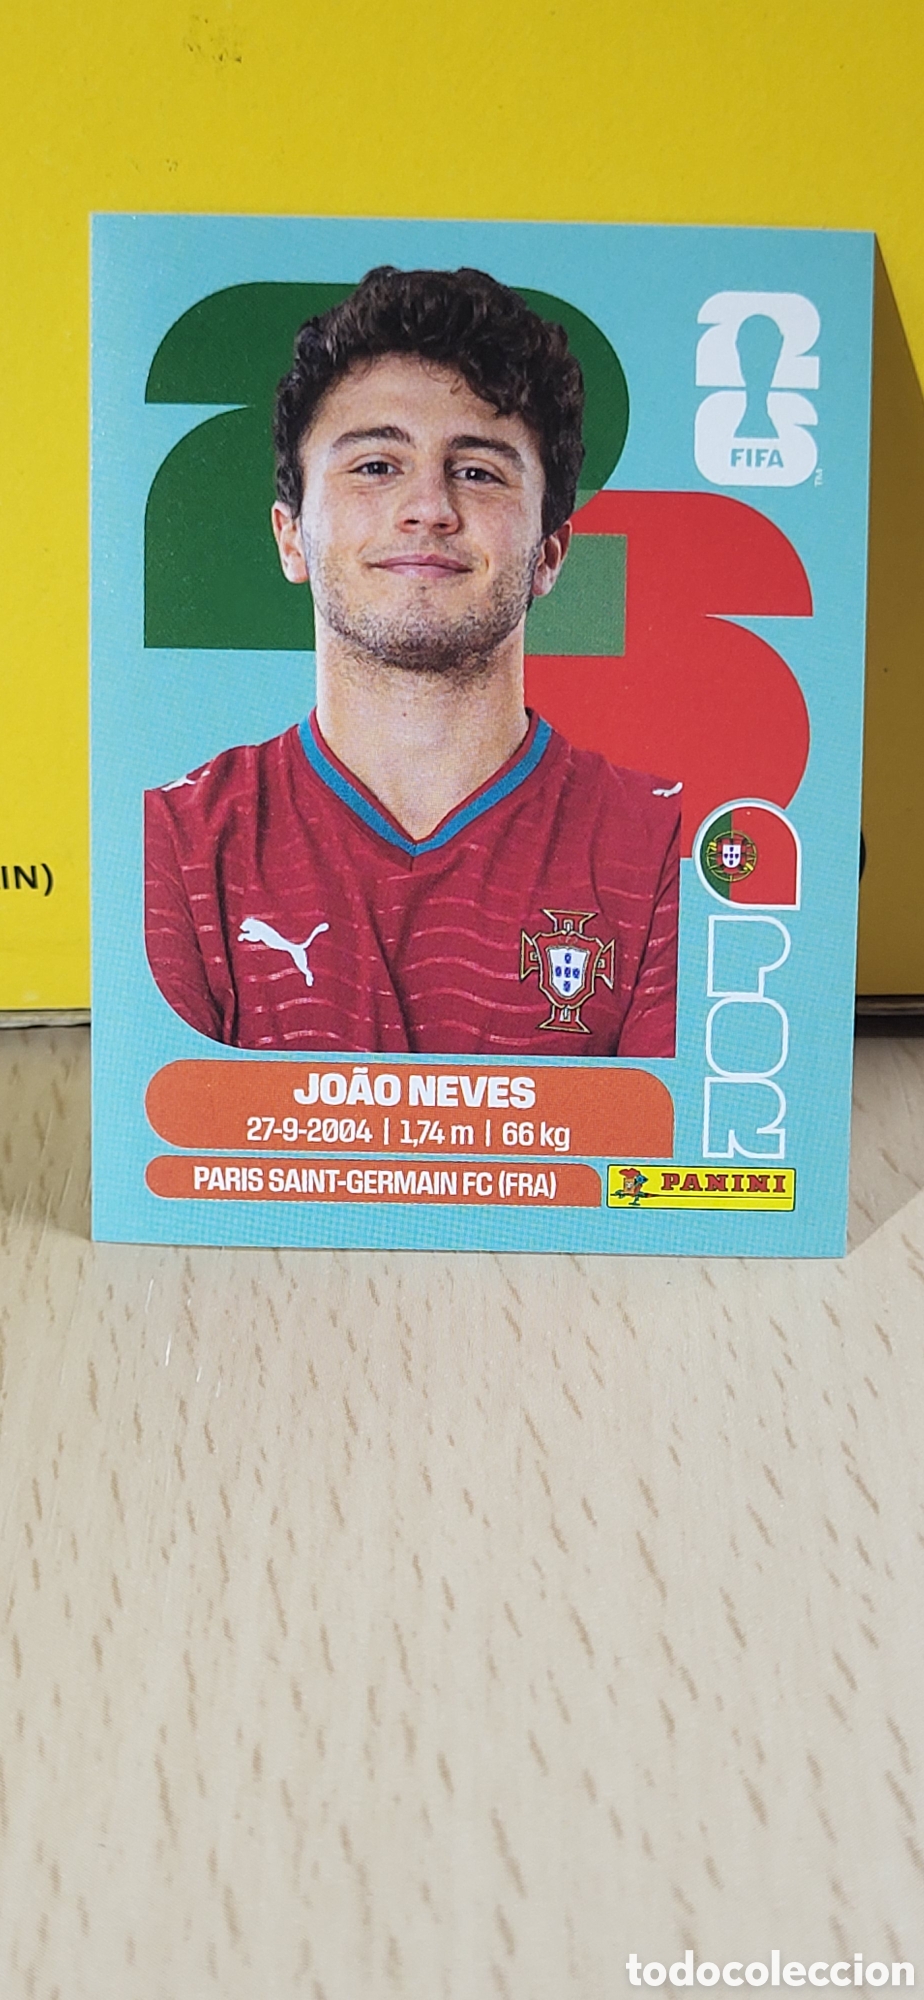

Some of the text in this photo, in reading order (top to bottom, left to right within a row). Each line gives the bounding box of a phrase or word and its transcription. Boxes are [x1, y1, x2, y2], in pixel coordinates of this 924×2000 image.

[730, 448, 784, 469] FIFA
[0, 863, 54, 897] IN)
[702, 914, 791, 1159] POR
[293, 1066, 536, 1109] JOÃO NEVES
[246, 1116, 373, 1143] 27-9-2004
[400, 1119, 445, 1148] 1,74
[450, 1124, 474, 1145] m
[502, 1121, 534, 1146] 66
[540, 1121, 571, 1151] kg
[193, 1165, 557, 1199] PARIS SAINT-GERMAIN FC (FRA)
[661, 1172, 786, 1193] PANINI
